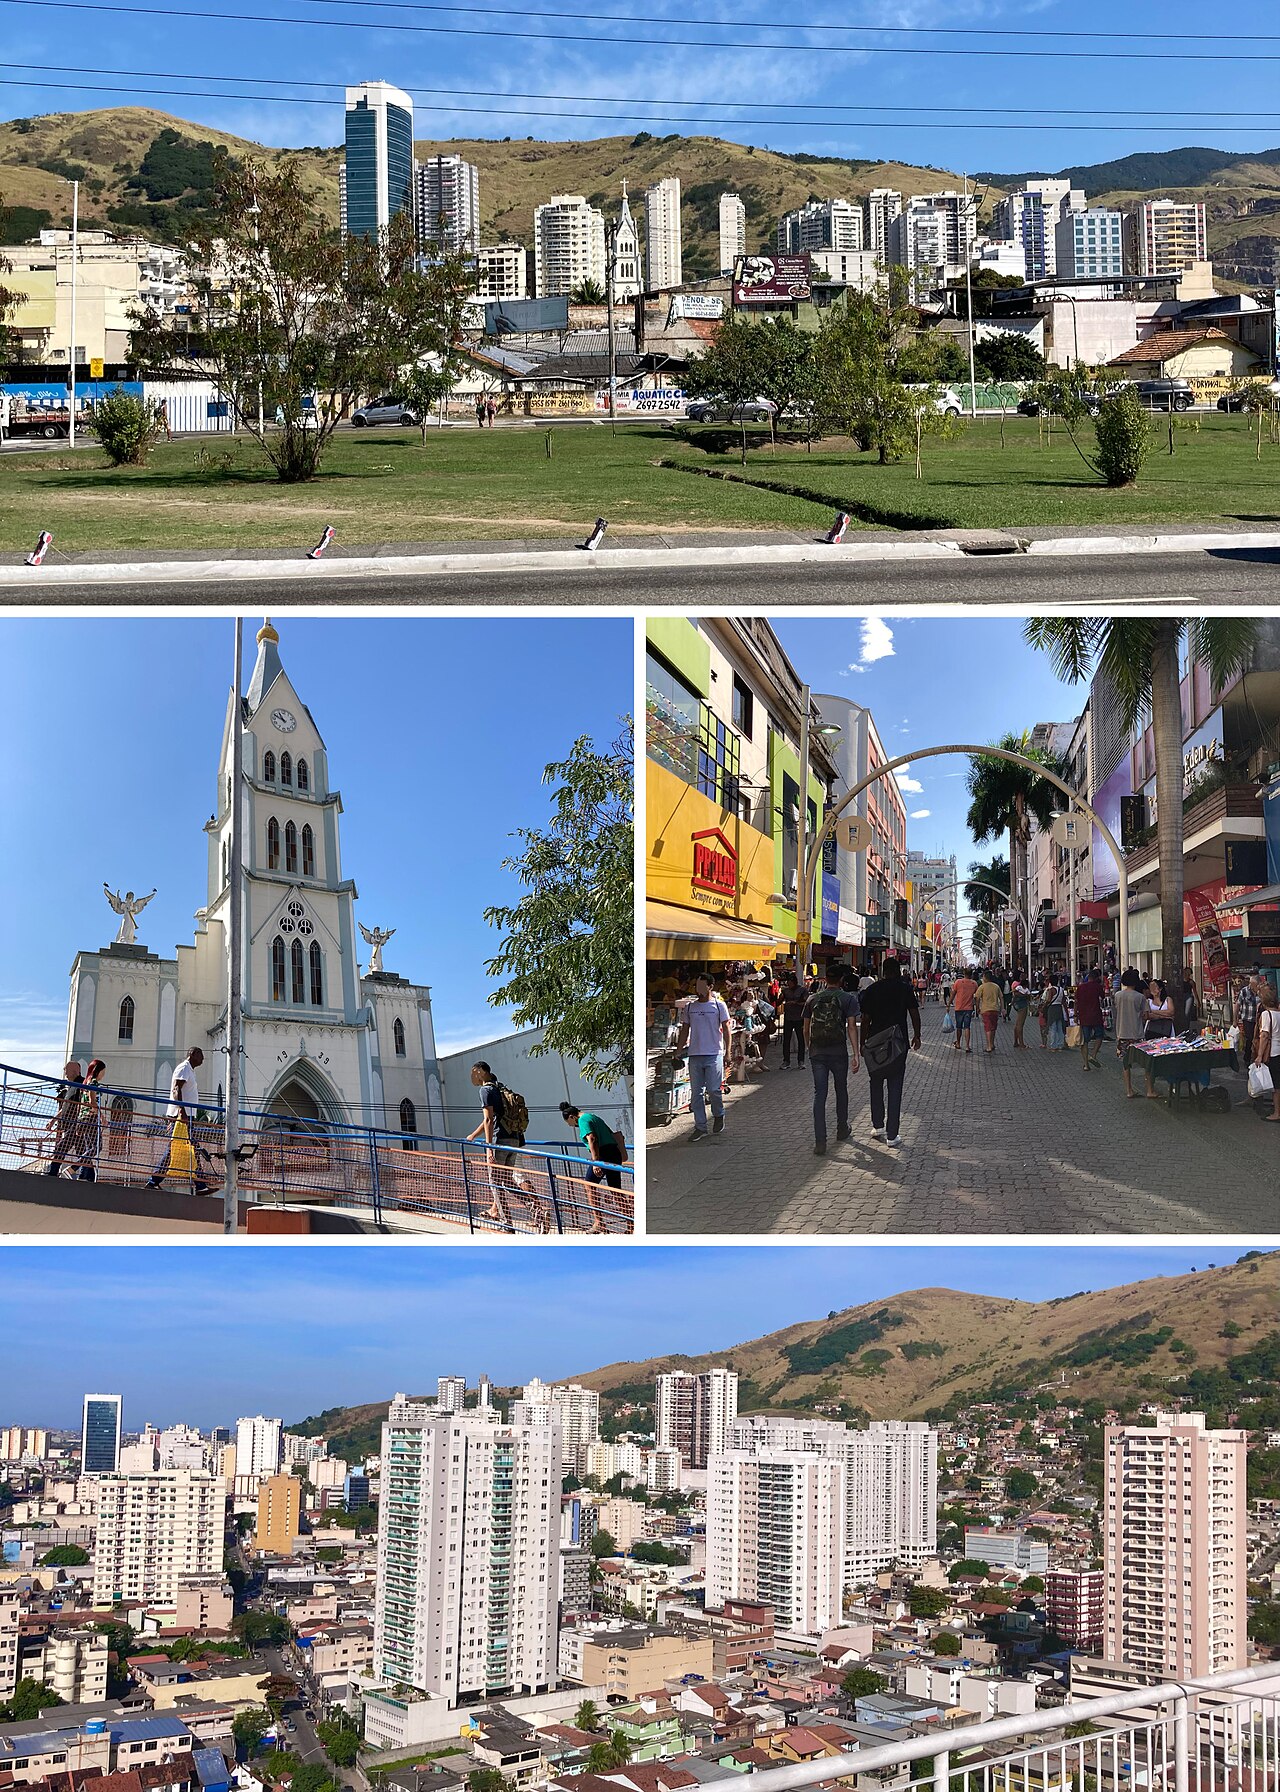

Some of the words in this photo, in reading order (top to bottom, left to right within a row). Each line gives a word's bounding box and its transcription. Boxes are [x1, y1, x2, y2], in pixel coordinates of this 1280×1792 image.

[632, 389, 672, 401] AQUATIC
[693, 842, 736, 887] PROLAR
[690, 887, 712, 906] Sempre
[712, 896, 723, 907] com
